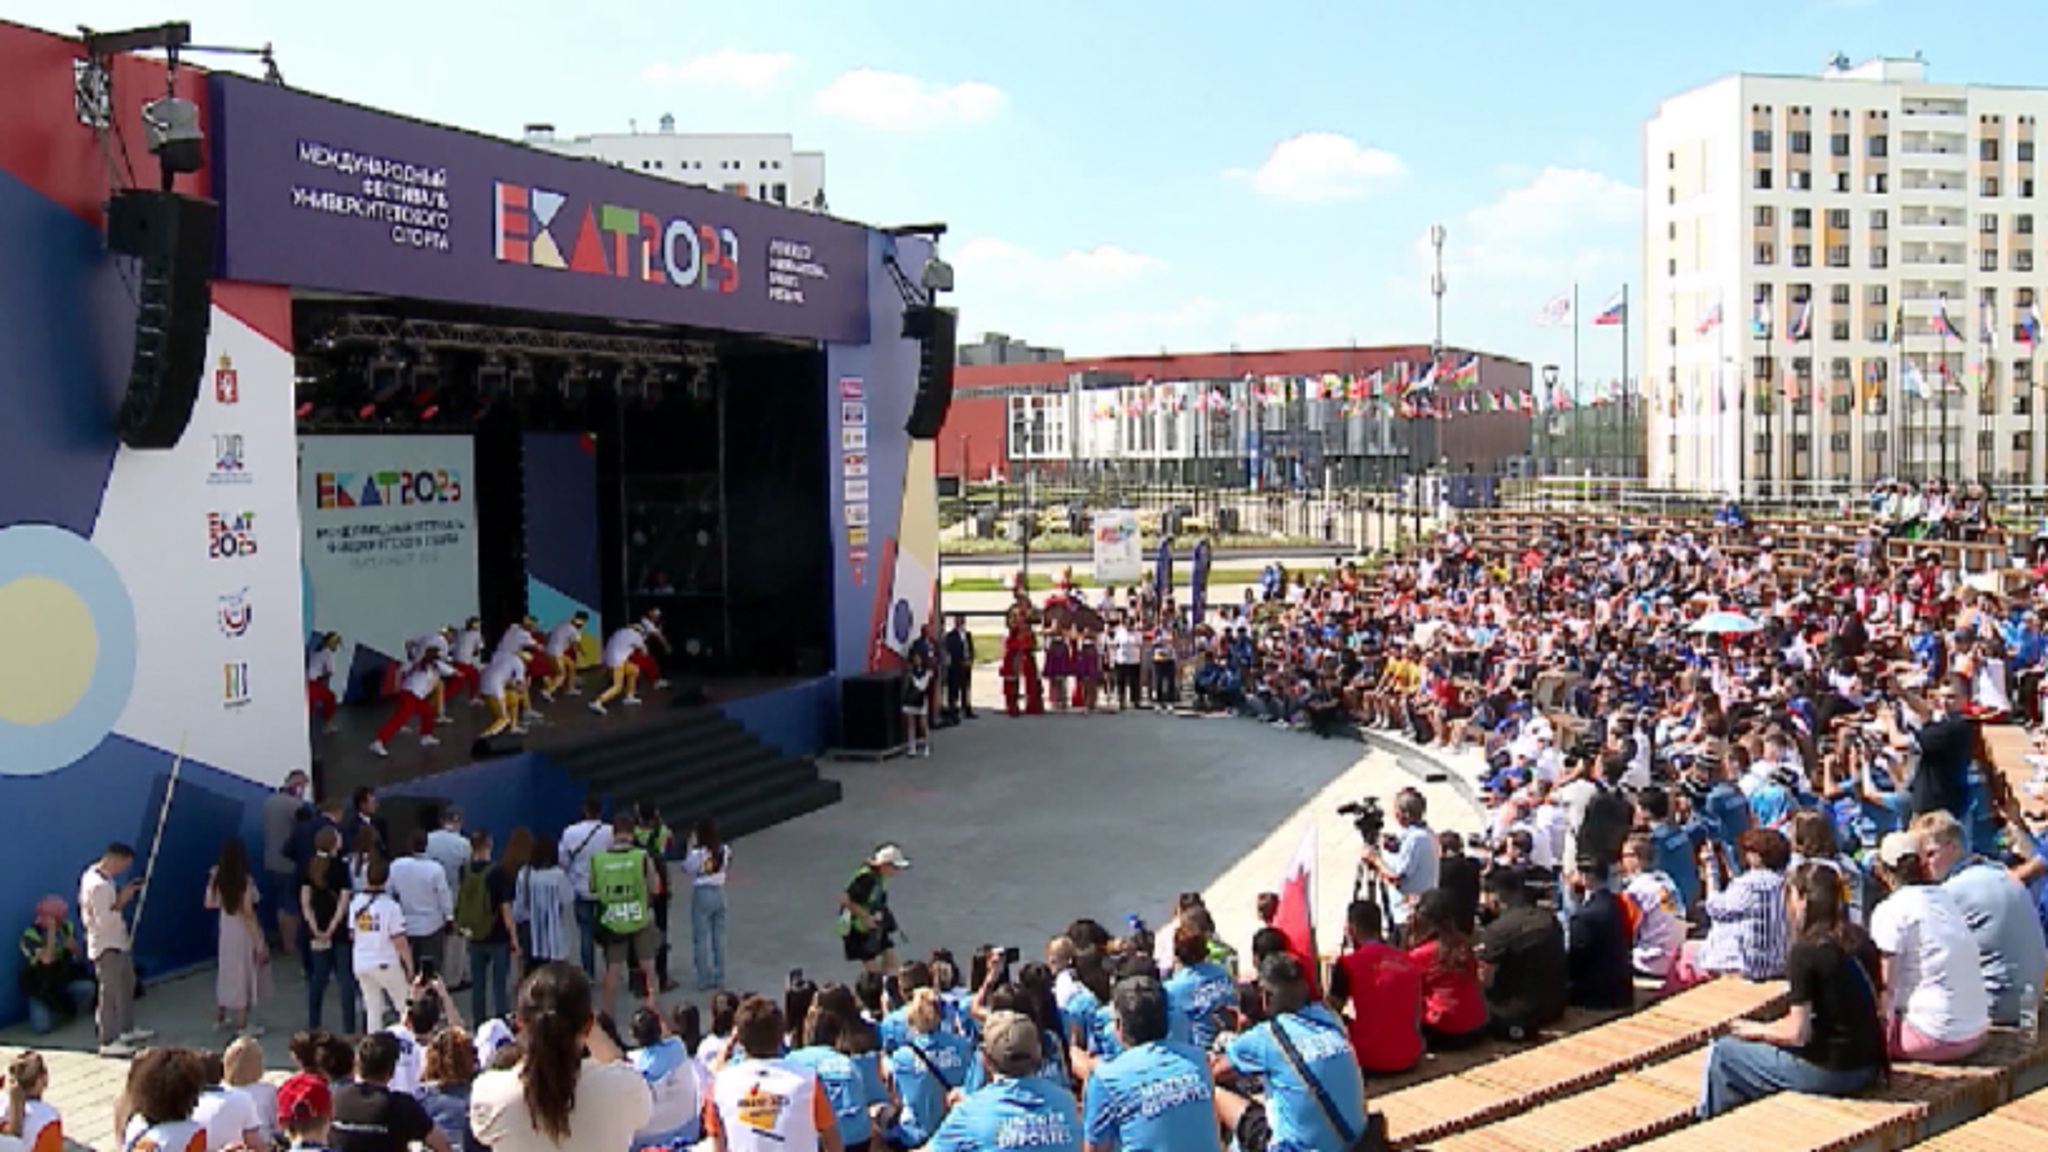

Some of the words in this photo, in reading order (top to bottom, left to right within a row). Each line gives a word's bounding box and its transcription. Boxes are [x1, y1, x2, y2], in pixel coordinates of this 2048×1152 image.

[300, 142, 446, 186] МЕЖДУНАРОДНЫЙ
[291, 187, 449, 229] УНИВЕРСИТЕТСКОГО
[362, 179, 449, 208] ФЕСТИВАЛЬ
[391, 225, 449, 250] СПОРТА
